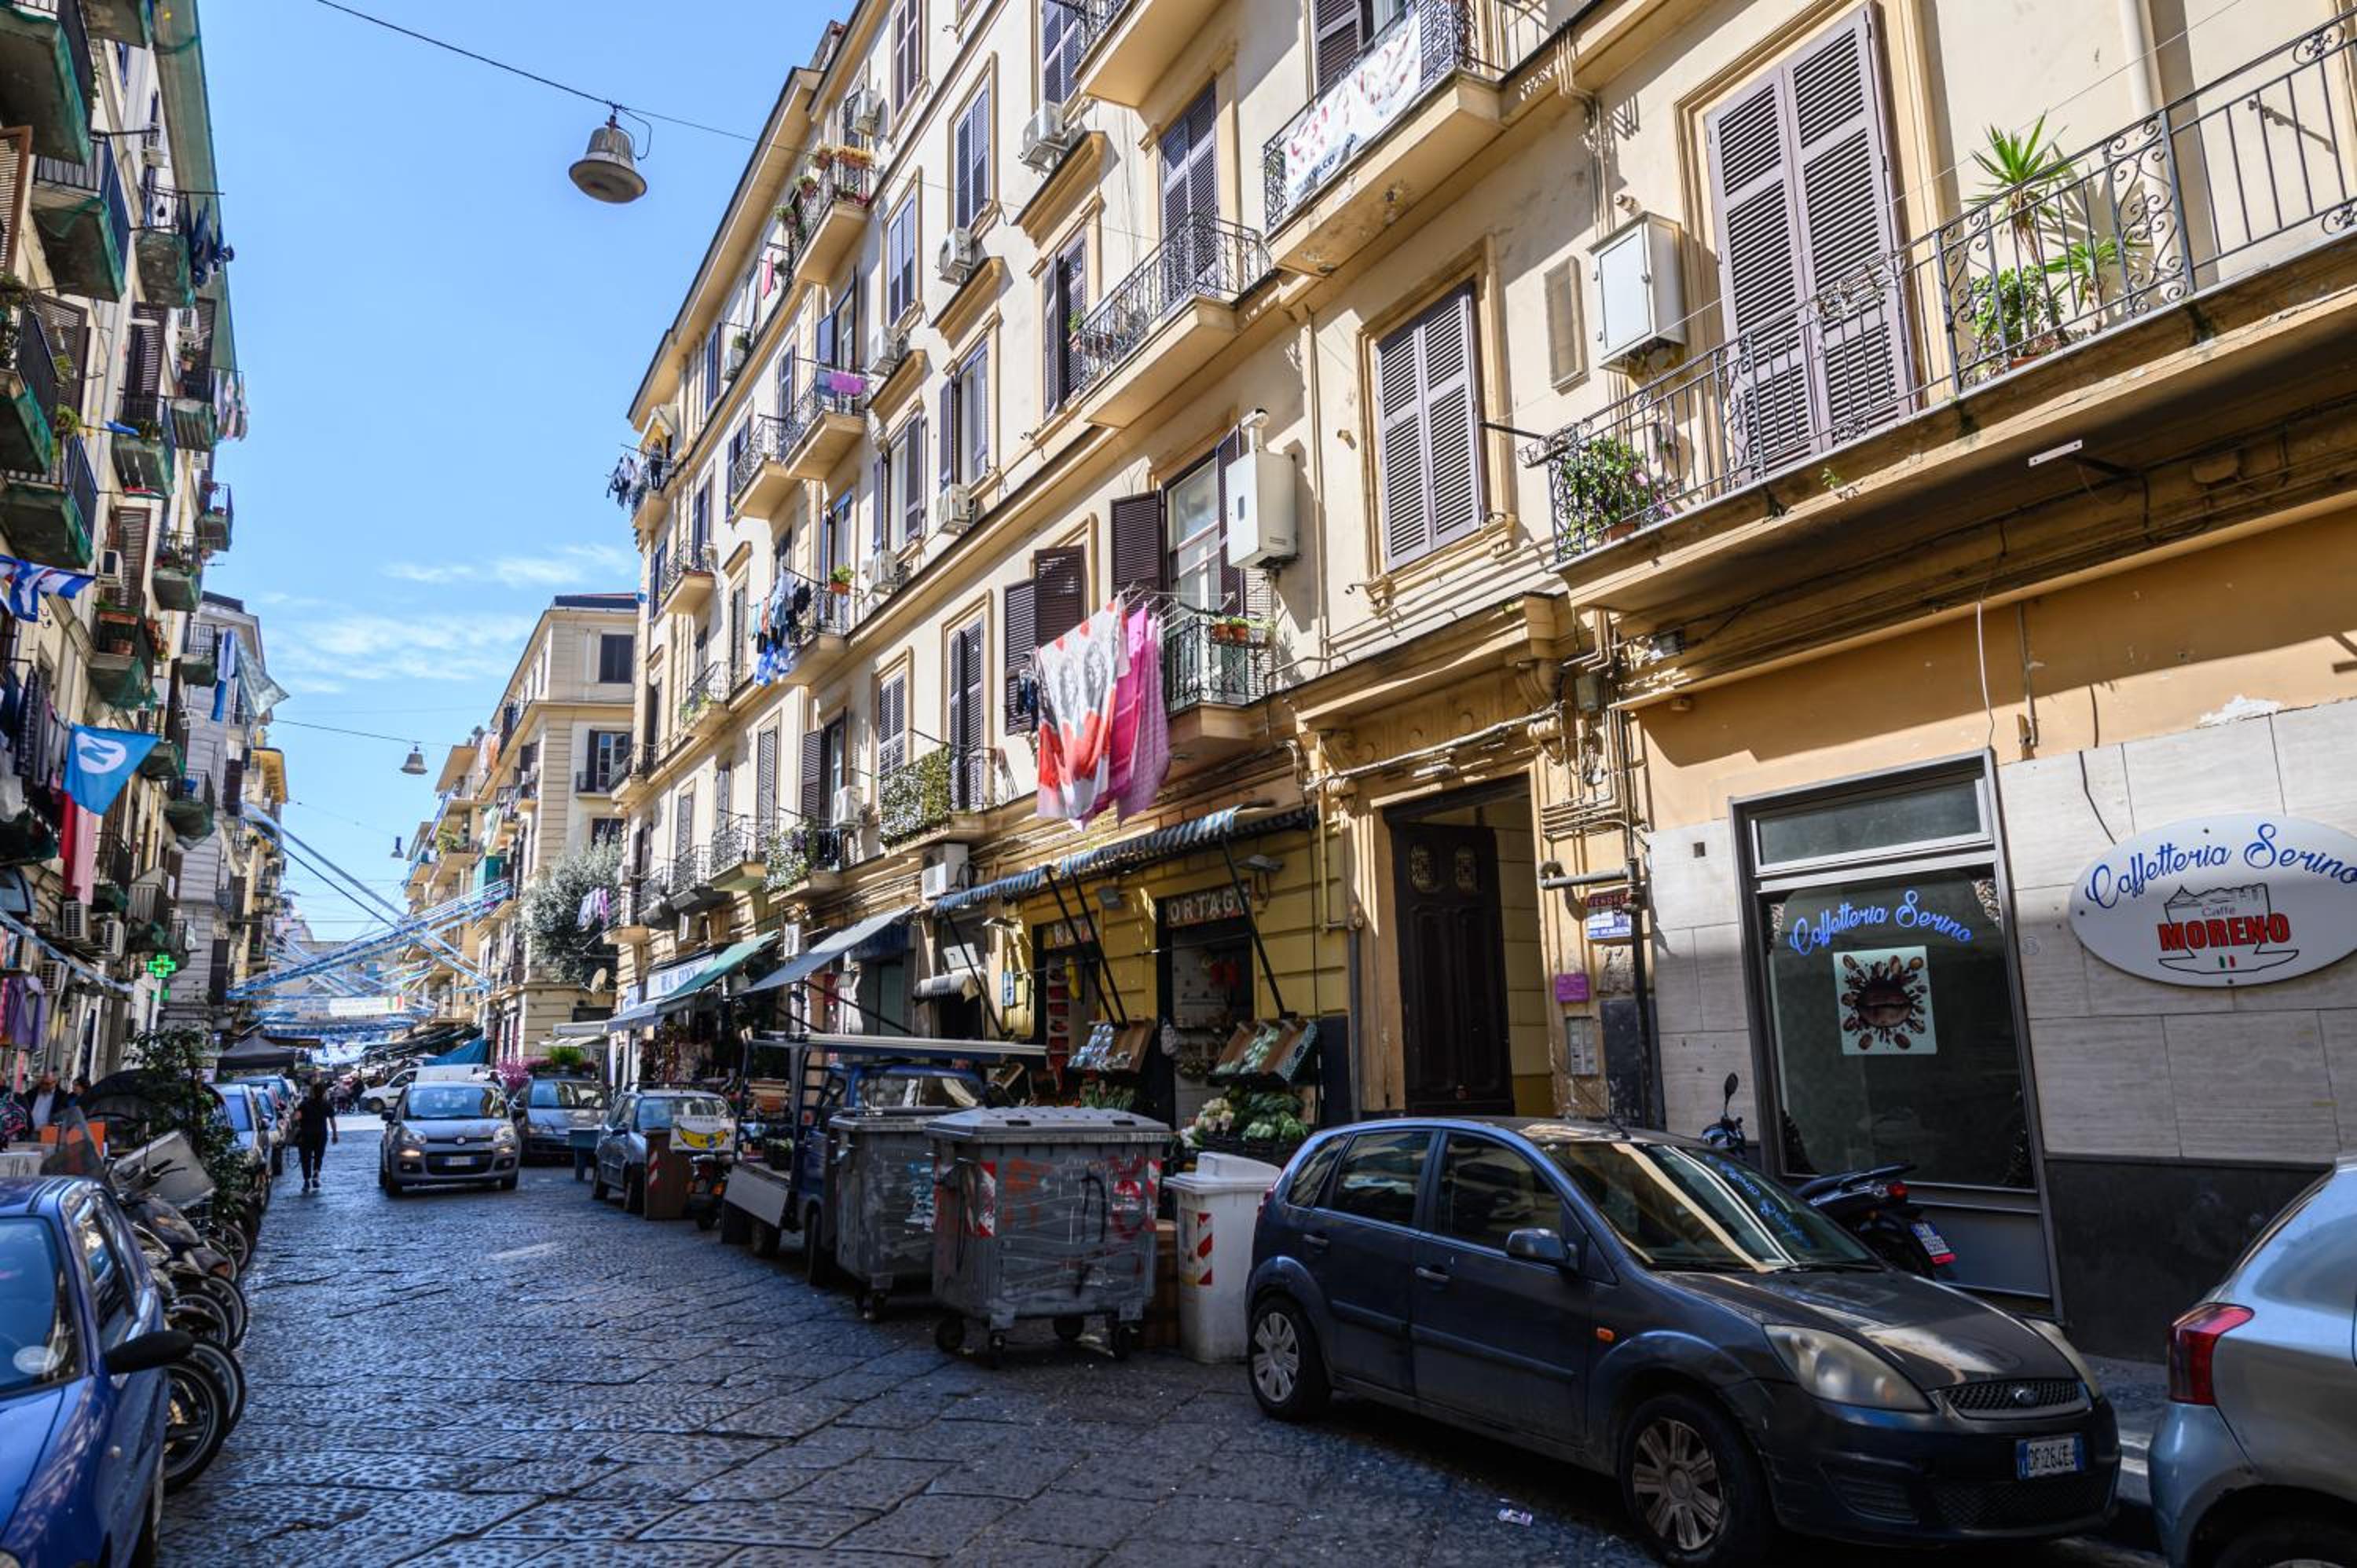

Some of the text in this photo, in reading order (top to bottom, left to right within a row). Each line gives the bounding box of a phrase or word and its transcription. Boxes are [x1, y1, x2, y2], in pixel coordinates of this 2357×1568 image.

[2085, 822, 2357, 909] Caffetteria Serino
[1790, 890, 1973, 956] Caffetteria Serino
[2157, 912, 2292, 951] MORENO
